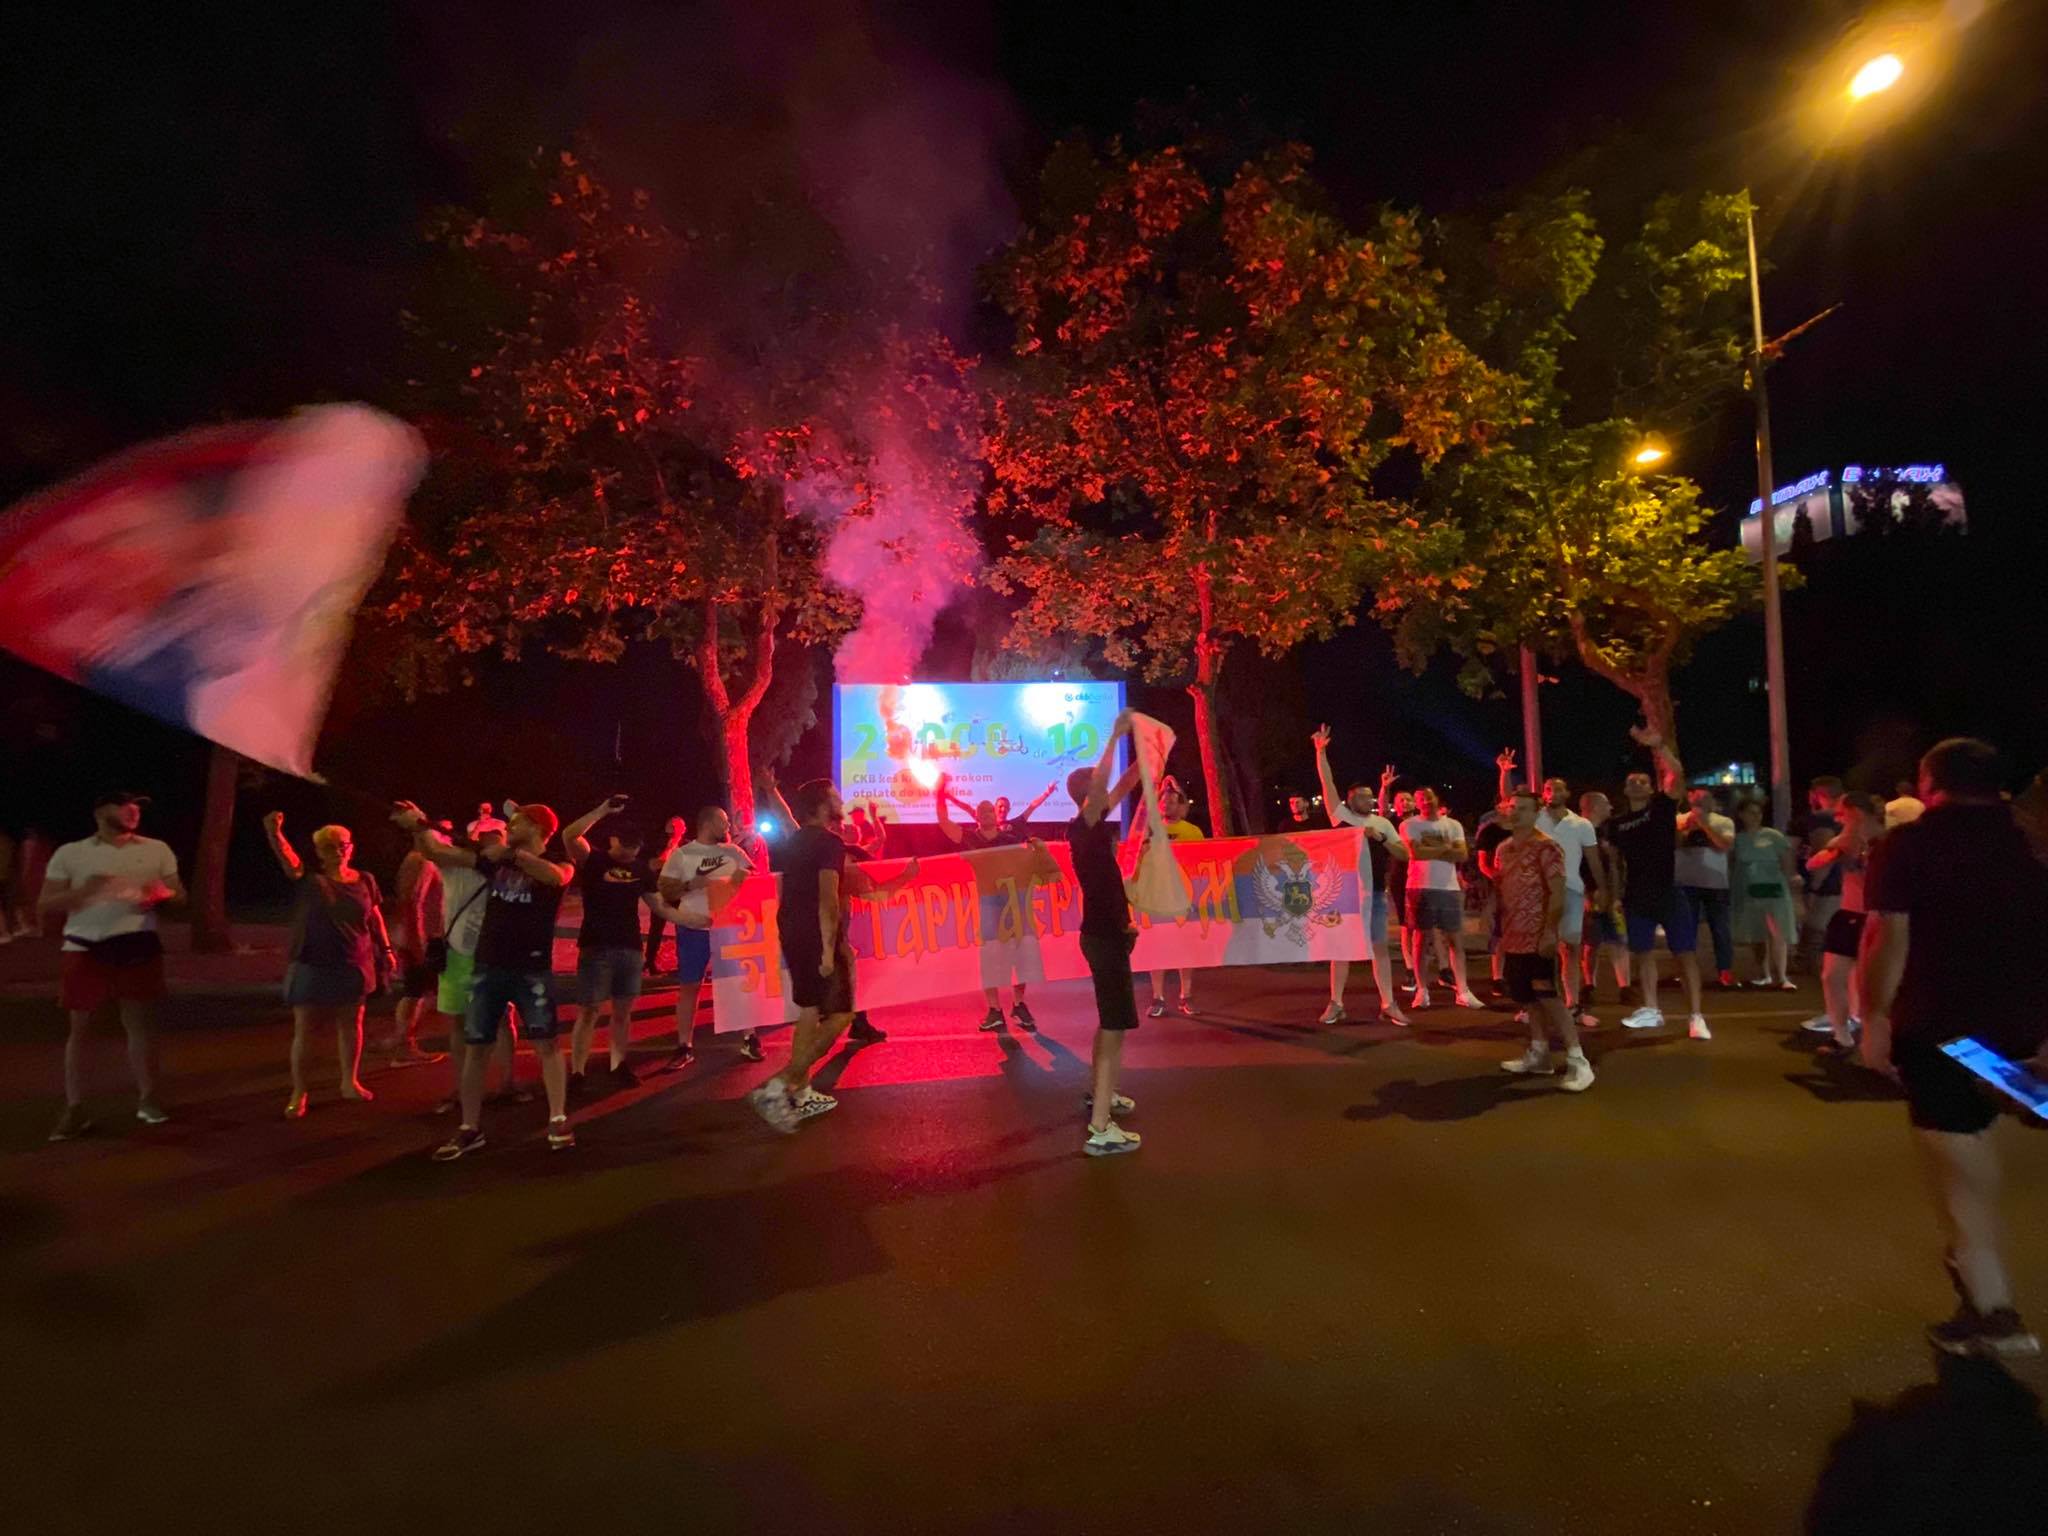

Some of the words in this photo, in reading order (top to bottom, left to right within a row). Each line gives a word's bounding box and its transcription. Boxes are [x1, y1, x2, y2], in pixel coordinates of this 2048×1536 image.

[853, 774, 876, 783] CKB
[956, 774, 993, 783] rokom
[853, 787, 896, 799] otplate
[700, 855, 725, 868] NIKE
[850, 880, 984, 963] ТАРИ
